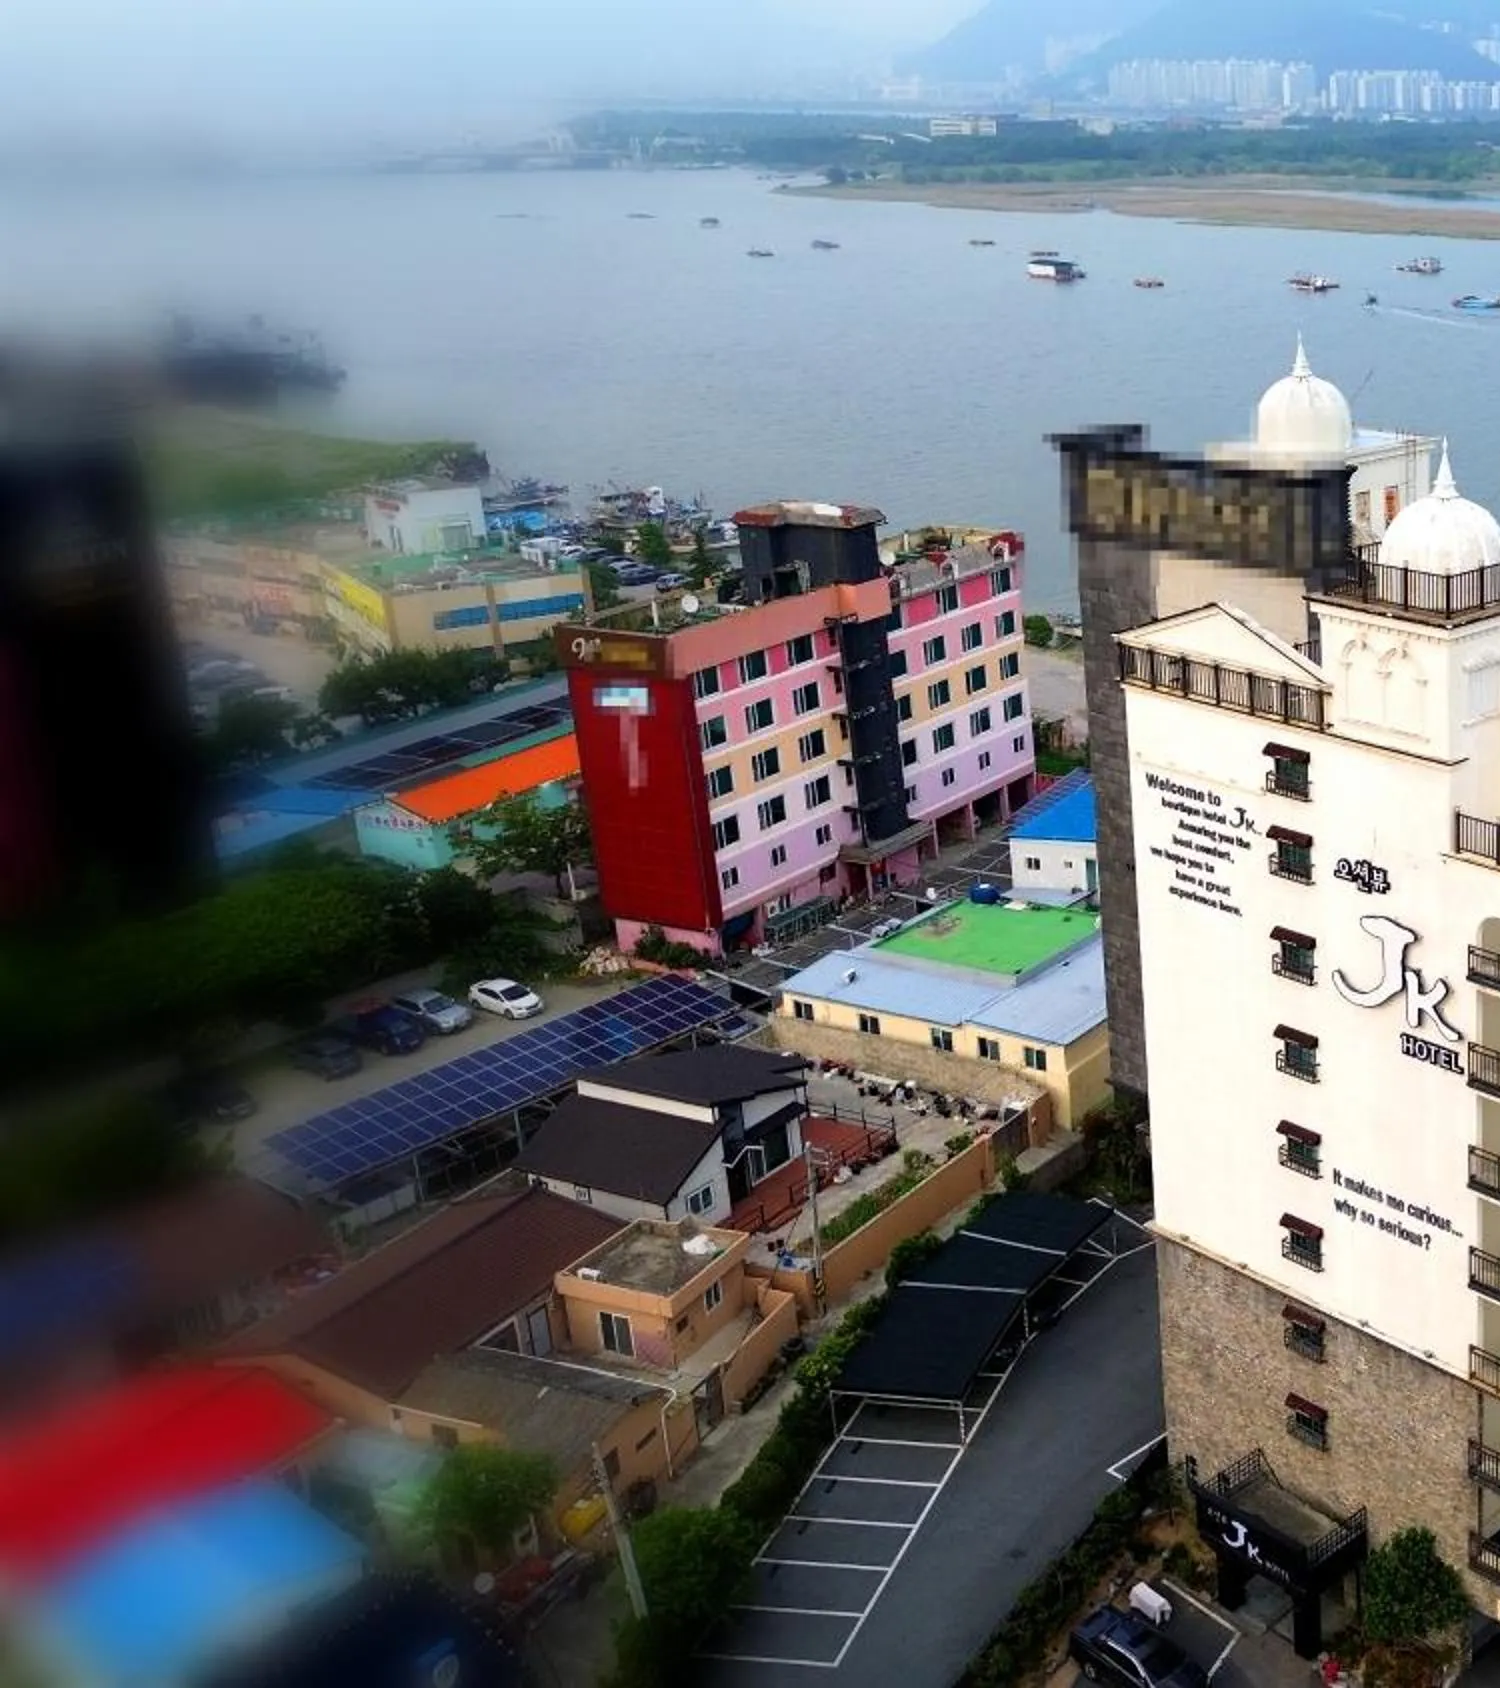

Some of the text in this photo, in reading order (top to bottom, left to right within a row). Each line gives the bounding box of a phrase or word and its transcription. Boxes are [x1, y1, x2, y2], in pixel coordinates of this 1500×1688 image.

[1145, 771, 1222, 807] Welcome to
[1202, 808, 1227, 825] hotel
[1172, 833, 1193, 850] best
[1217, 833, 1235, 846] you
[1235, 835, 1251, 850] the
[1163, 848, 1187, 865] hope
[1187, 858, 1203, 870] you
[1204, 862, 1215, 874] to
[1334, 858, 1391, 894] 오션뷰
[1175, 868, 1197, 885] have
[1197, 878, 1205, 888] a
[1400, 1032, 1465, 1075] HOTEL
[1332, 1167, 1343, 1187] It
[1343, 1175, 1384, 1203] makes
[1385, 1192, 1405, 1213] me
[1333, 1197, 1431, 1251] why so serious?
